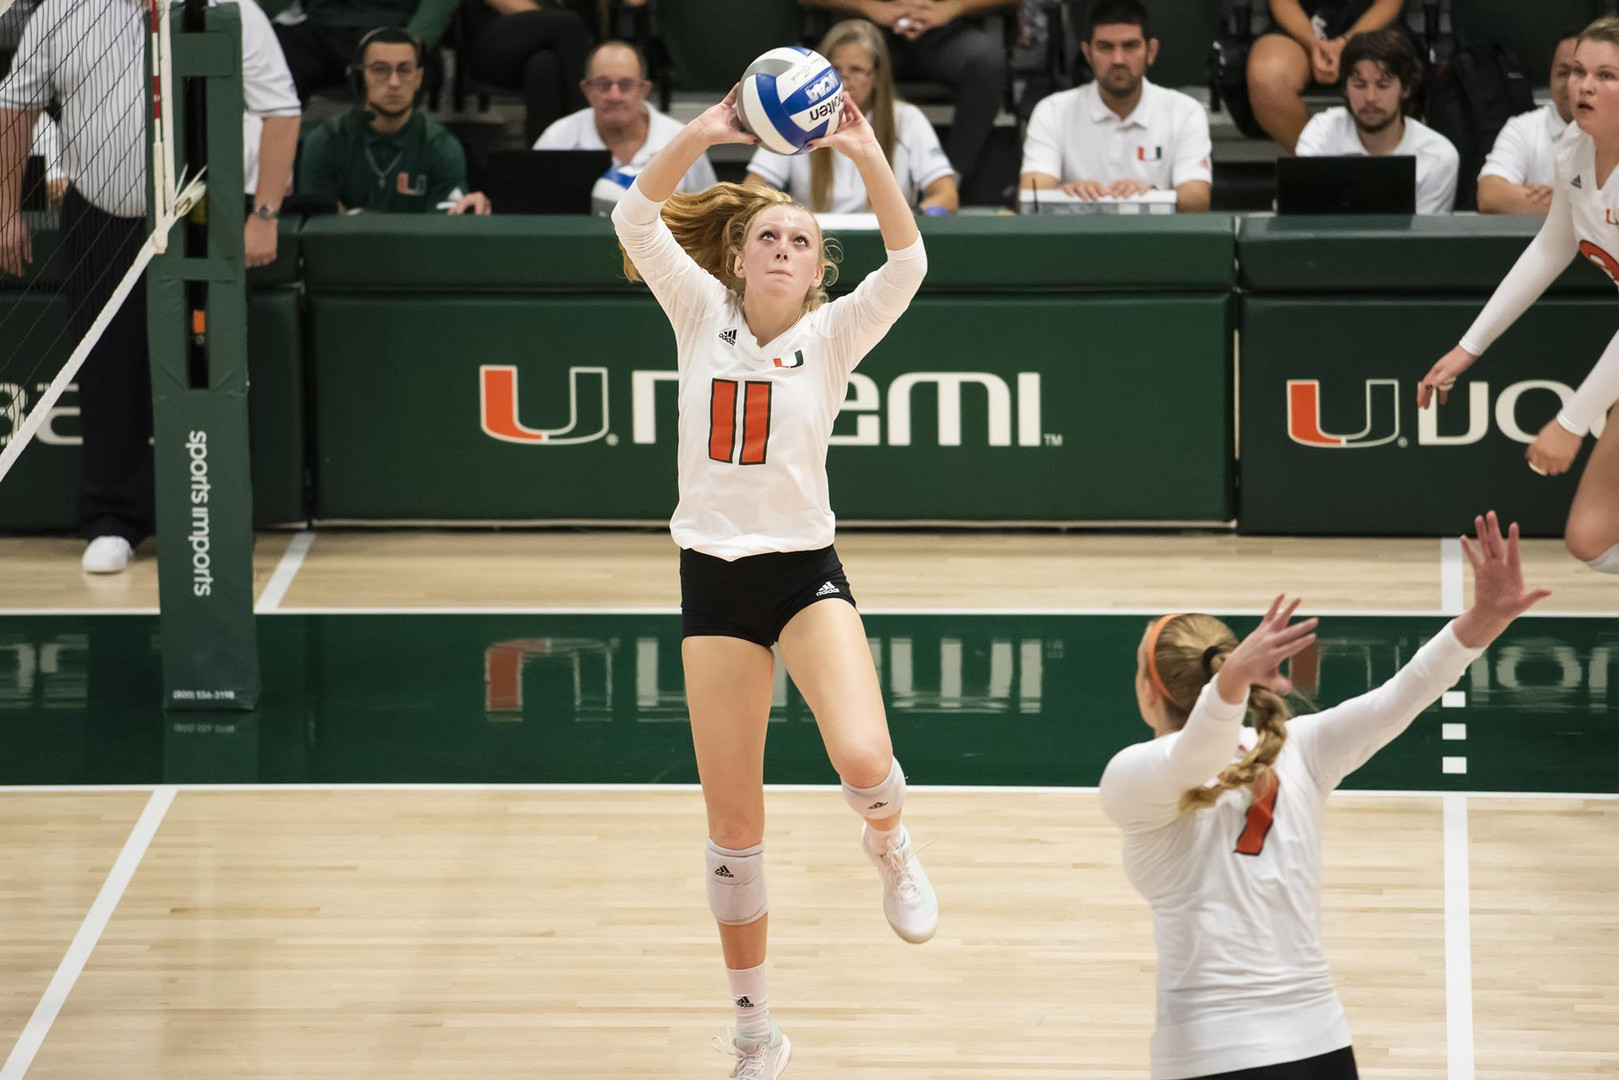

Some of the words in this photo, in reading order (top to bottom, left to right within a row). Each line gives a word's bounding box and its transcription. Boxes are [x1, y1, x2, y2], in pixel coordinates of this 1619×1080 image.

[479, 364, 609, 445] U
[708, 378, 772, 466] 11
[1286, 379, 1399, 448] U
[185, 430, 211, 504] sports
[188, 507, 214, 597] imports
